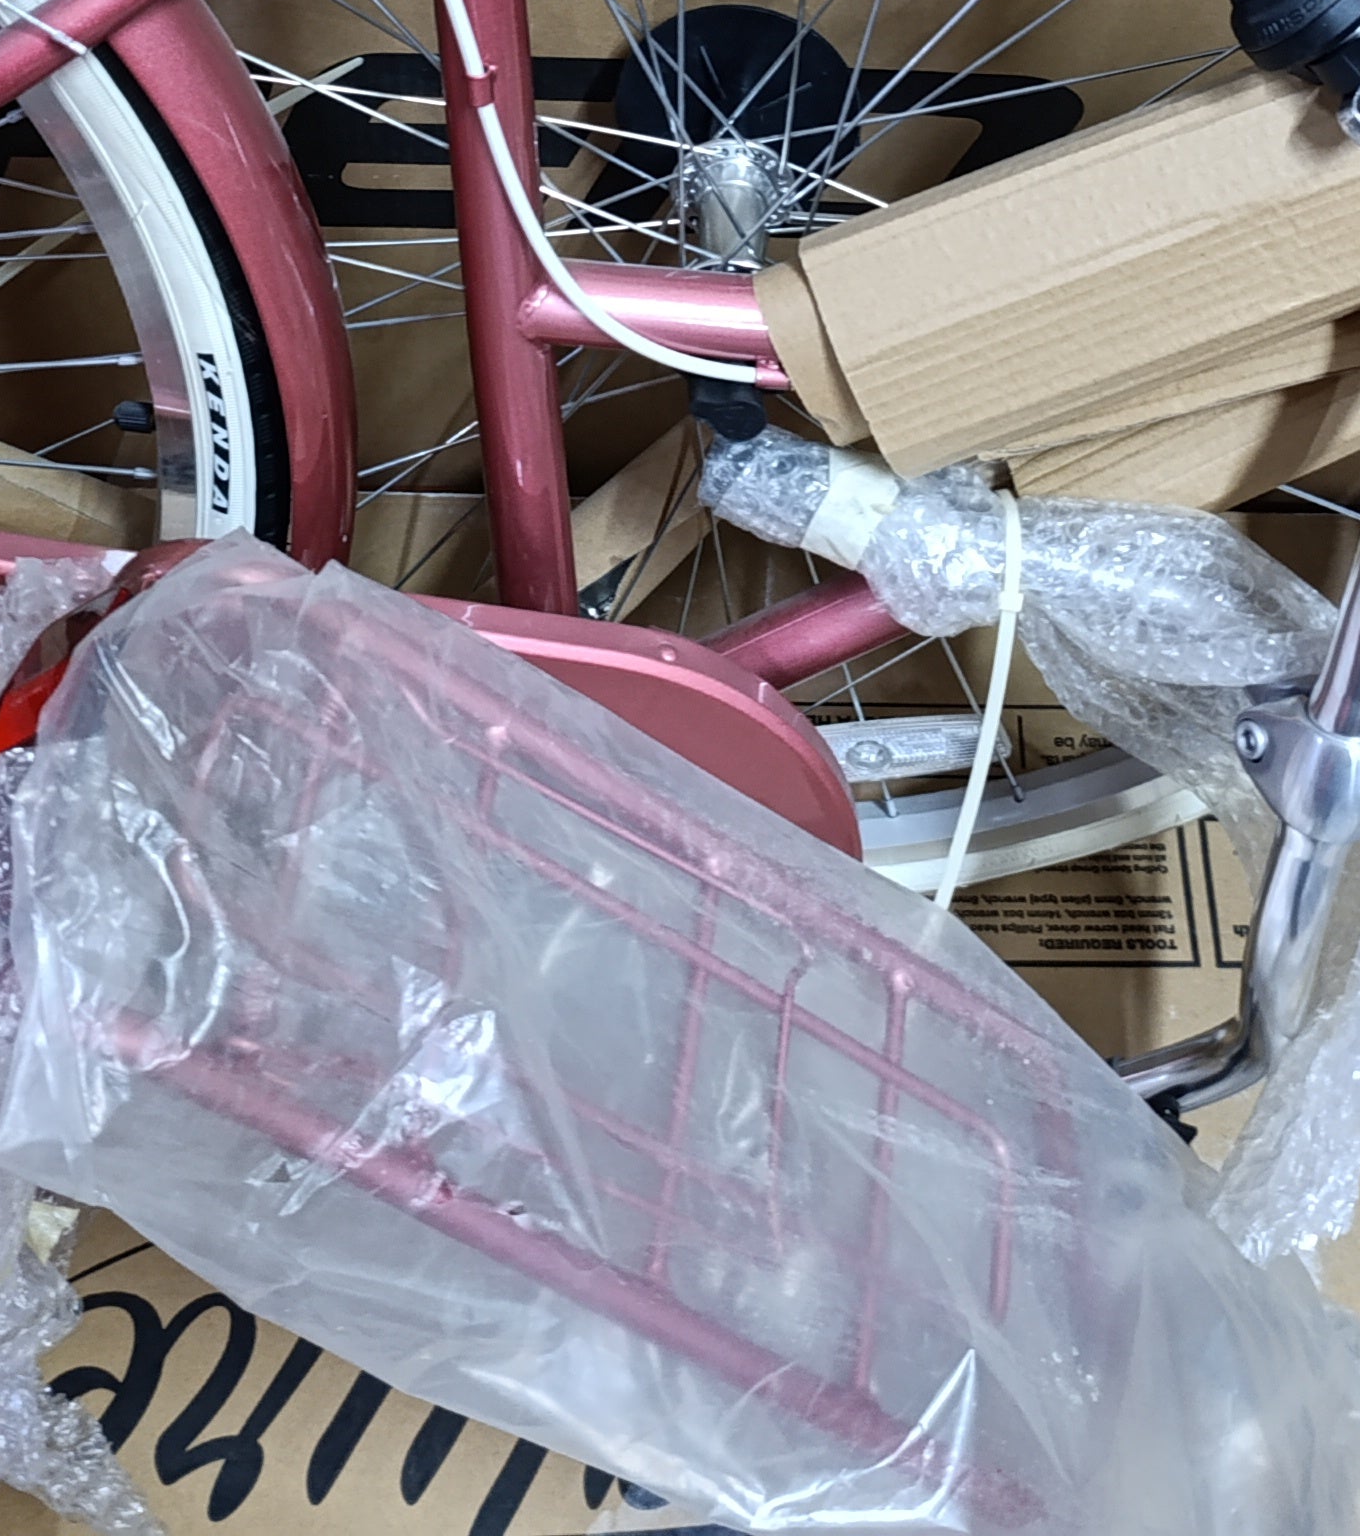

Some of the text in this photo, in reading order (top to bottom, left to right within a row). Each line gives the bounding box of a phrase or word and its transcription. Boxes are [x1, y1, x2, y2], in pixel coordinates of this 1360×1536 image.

[198, 358, 230, 511] KENDA
[1038, 937, 1179, 951] TOOLS REQUIRED:
